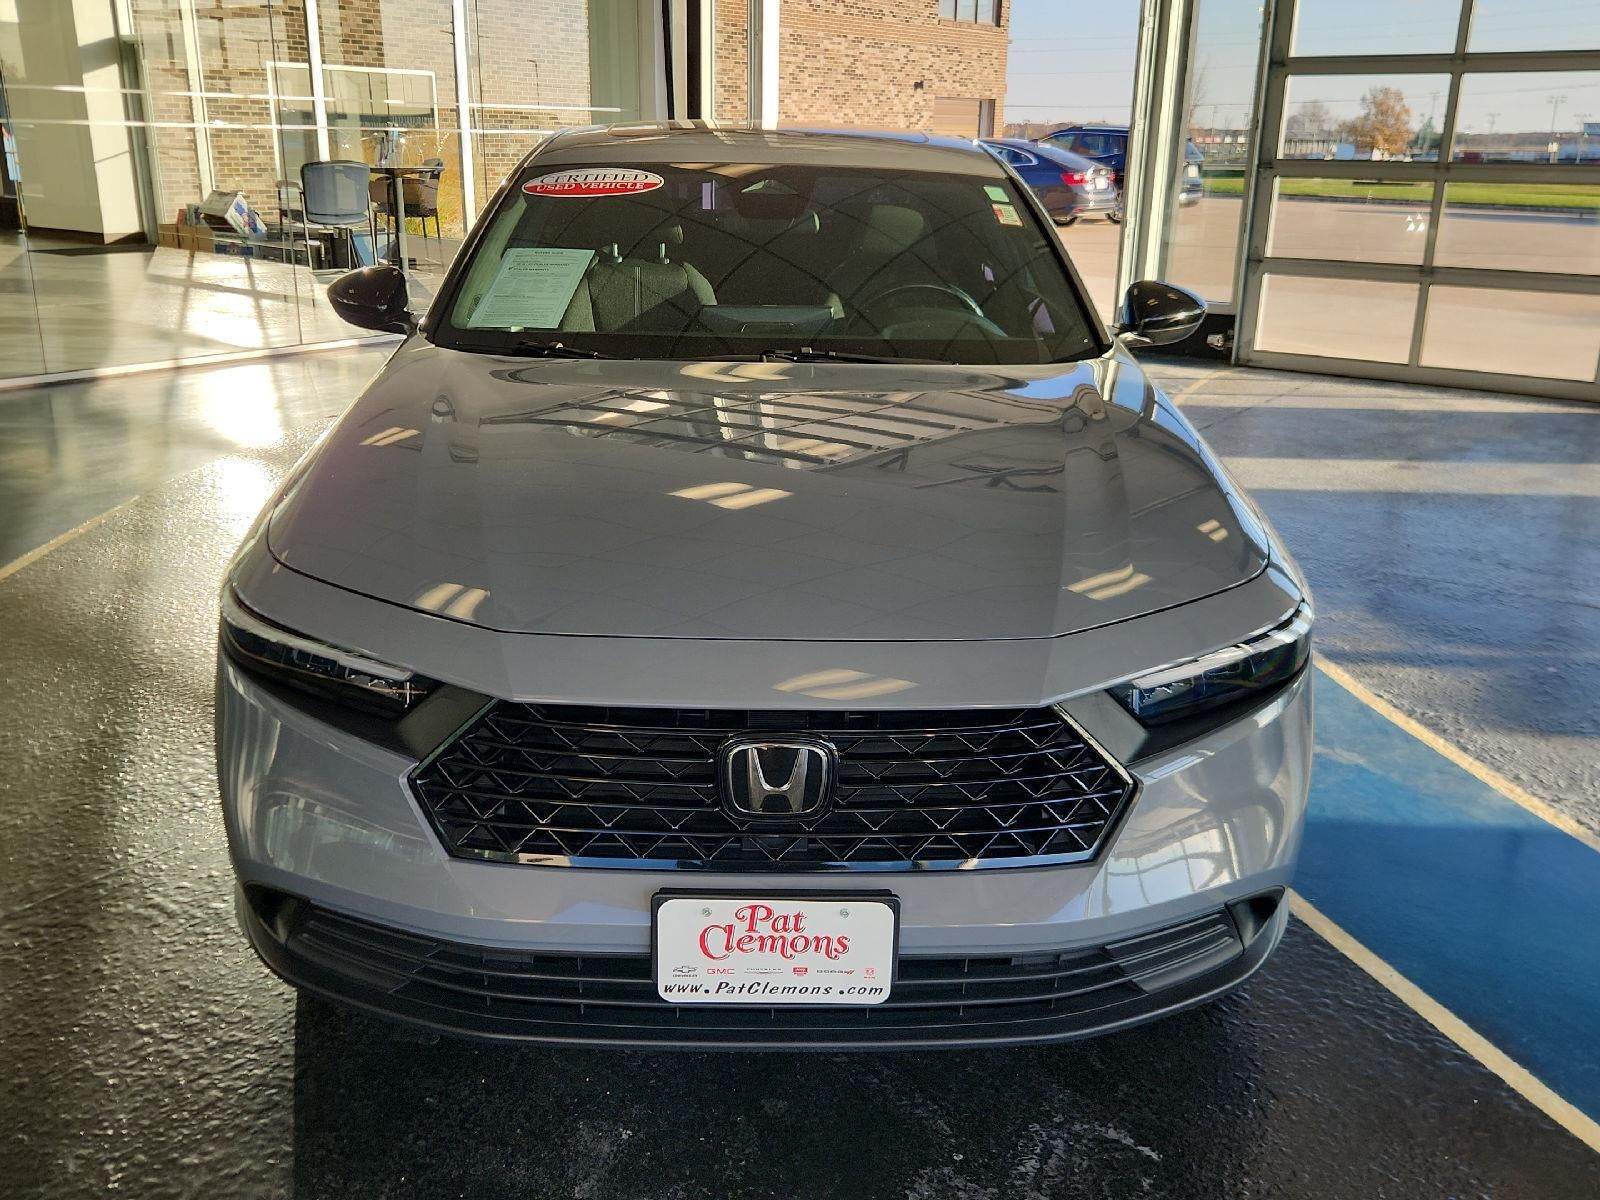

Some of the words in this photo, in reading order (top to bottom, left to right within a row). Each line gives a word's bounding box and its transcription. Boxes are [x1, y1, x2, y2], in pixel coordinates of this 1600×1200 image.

[536, 183, 576, 192] USED
[580, 182, 645, 190] VEHICLE
[540, 173, 649, 184] CERTIFIED
[735, 904, 806, 934] Pat
[699, 923, 851, 961] Clemons
